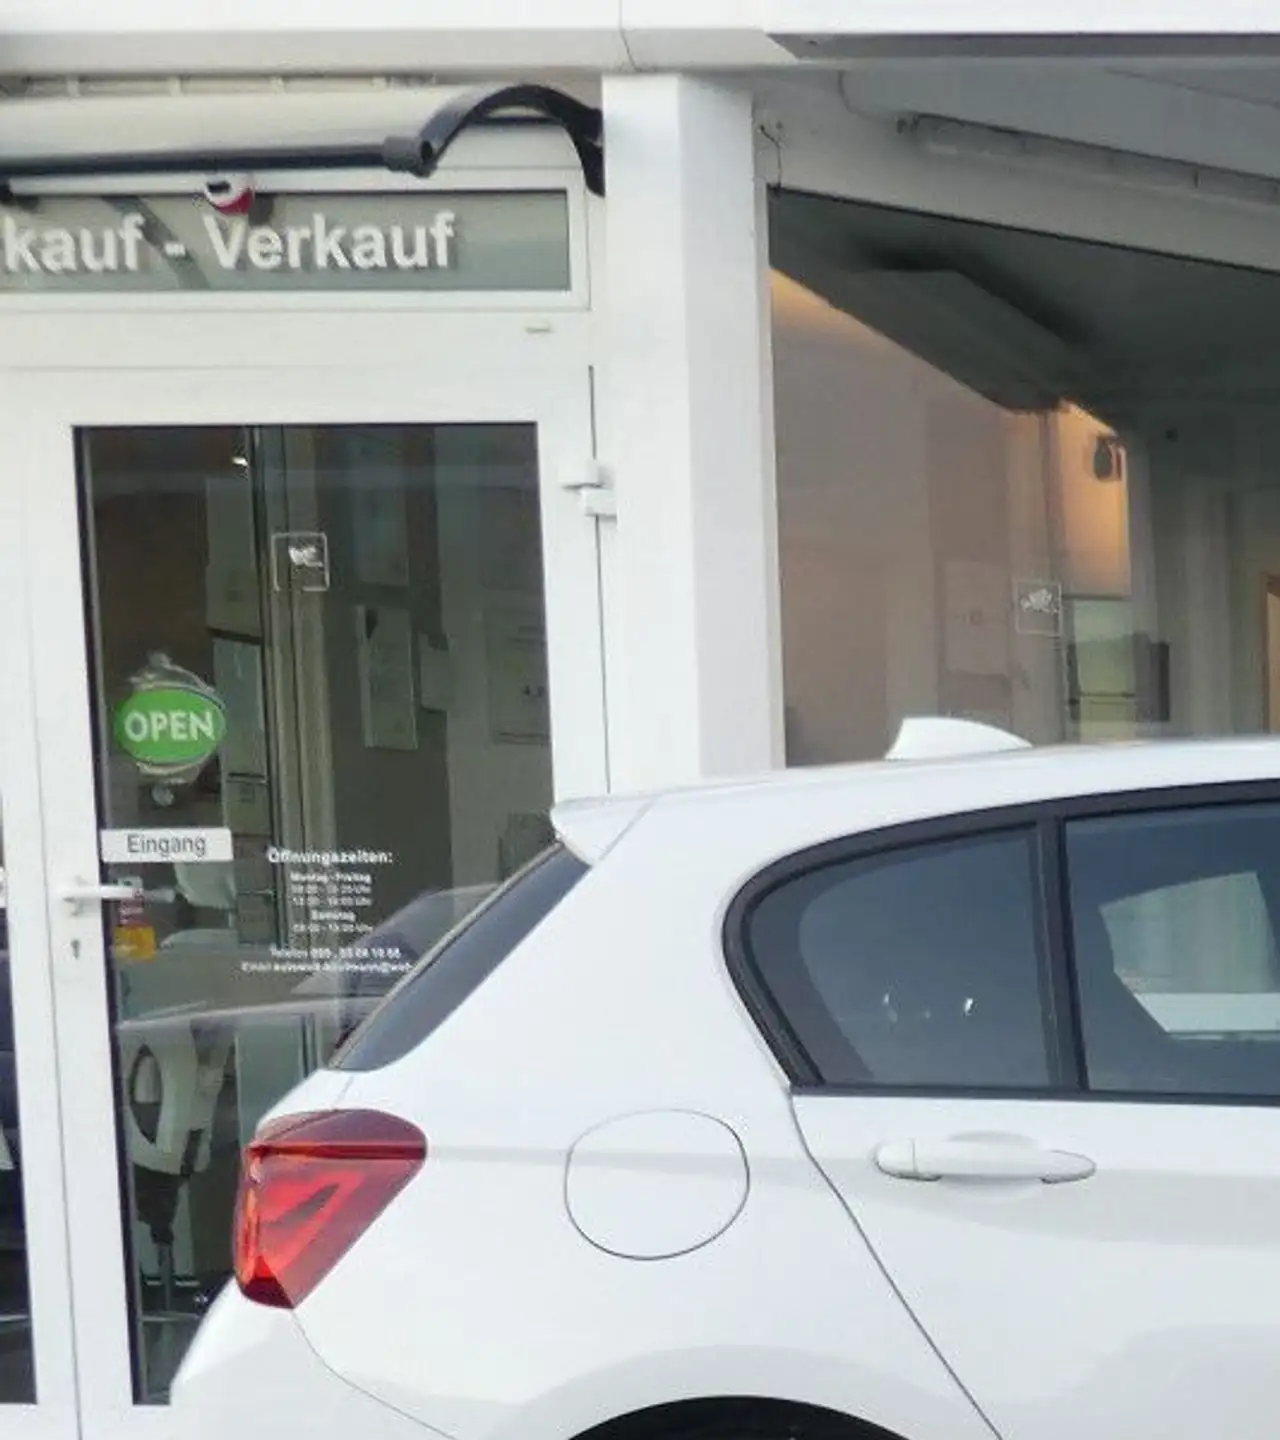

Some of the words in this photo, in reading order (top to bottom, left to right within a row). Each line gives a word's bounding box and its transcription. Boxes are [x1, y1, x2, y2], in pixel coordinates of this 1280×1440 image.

[4, 212, 145, 272] kauf
[203, 210, 456, 270] Verkauf
[124, 710, 215, 742] OPEN
[127, 834, 206, 857] Eingang
